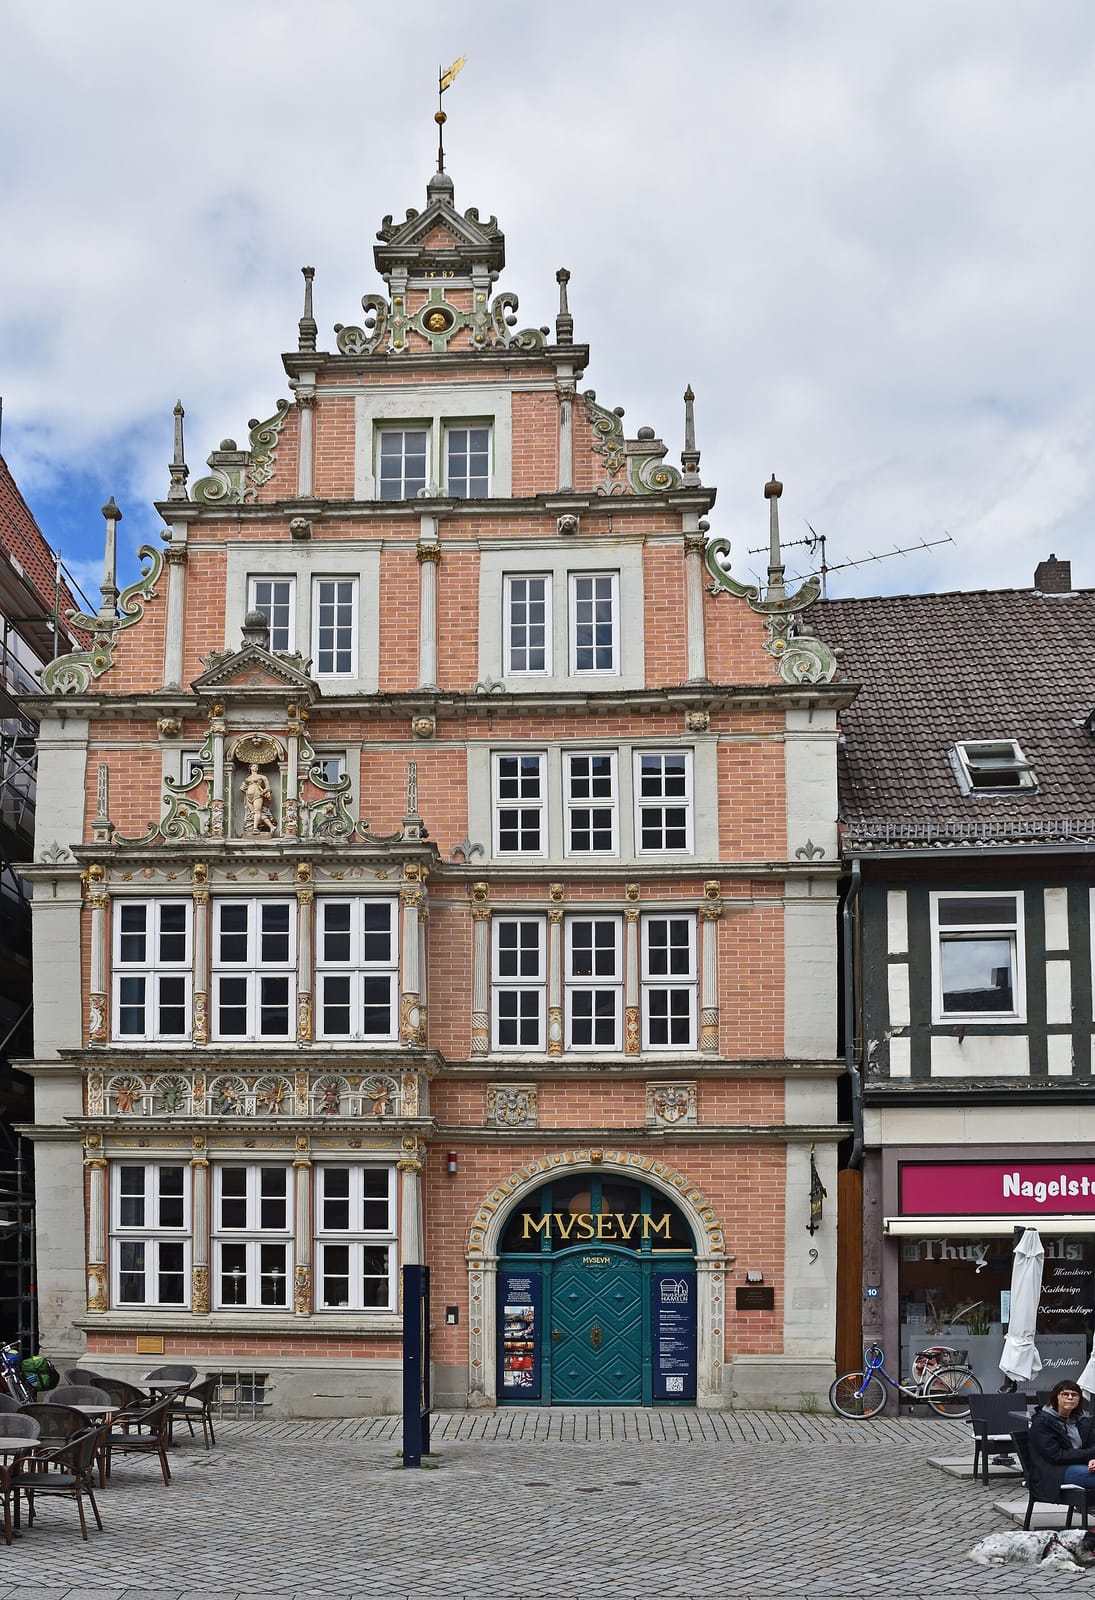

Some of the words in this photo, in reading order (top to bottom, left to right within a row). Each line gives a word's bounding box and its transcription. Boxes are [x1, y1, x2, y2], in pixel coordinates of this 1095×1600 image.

[521, 1213, 672, 1239] MVSEVM
[582, 1256, 610, 1264] MVSEVM
[809, 1248, 819, 1265] 9
[918, 1237, 990, 1274] Thuy
[867, 1288, 877, 1296] 10
[1042, 1358, 1079, 1369] Auffüllen
